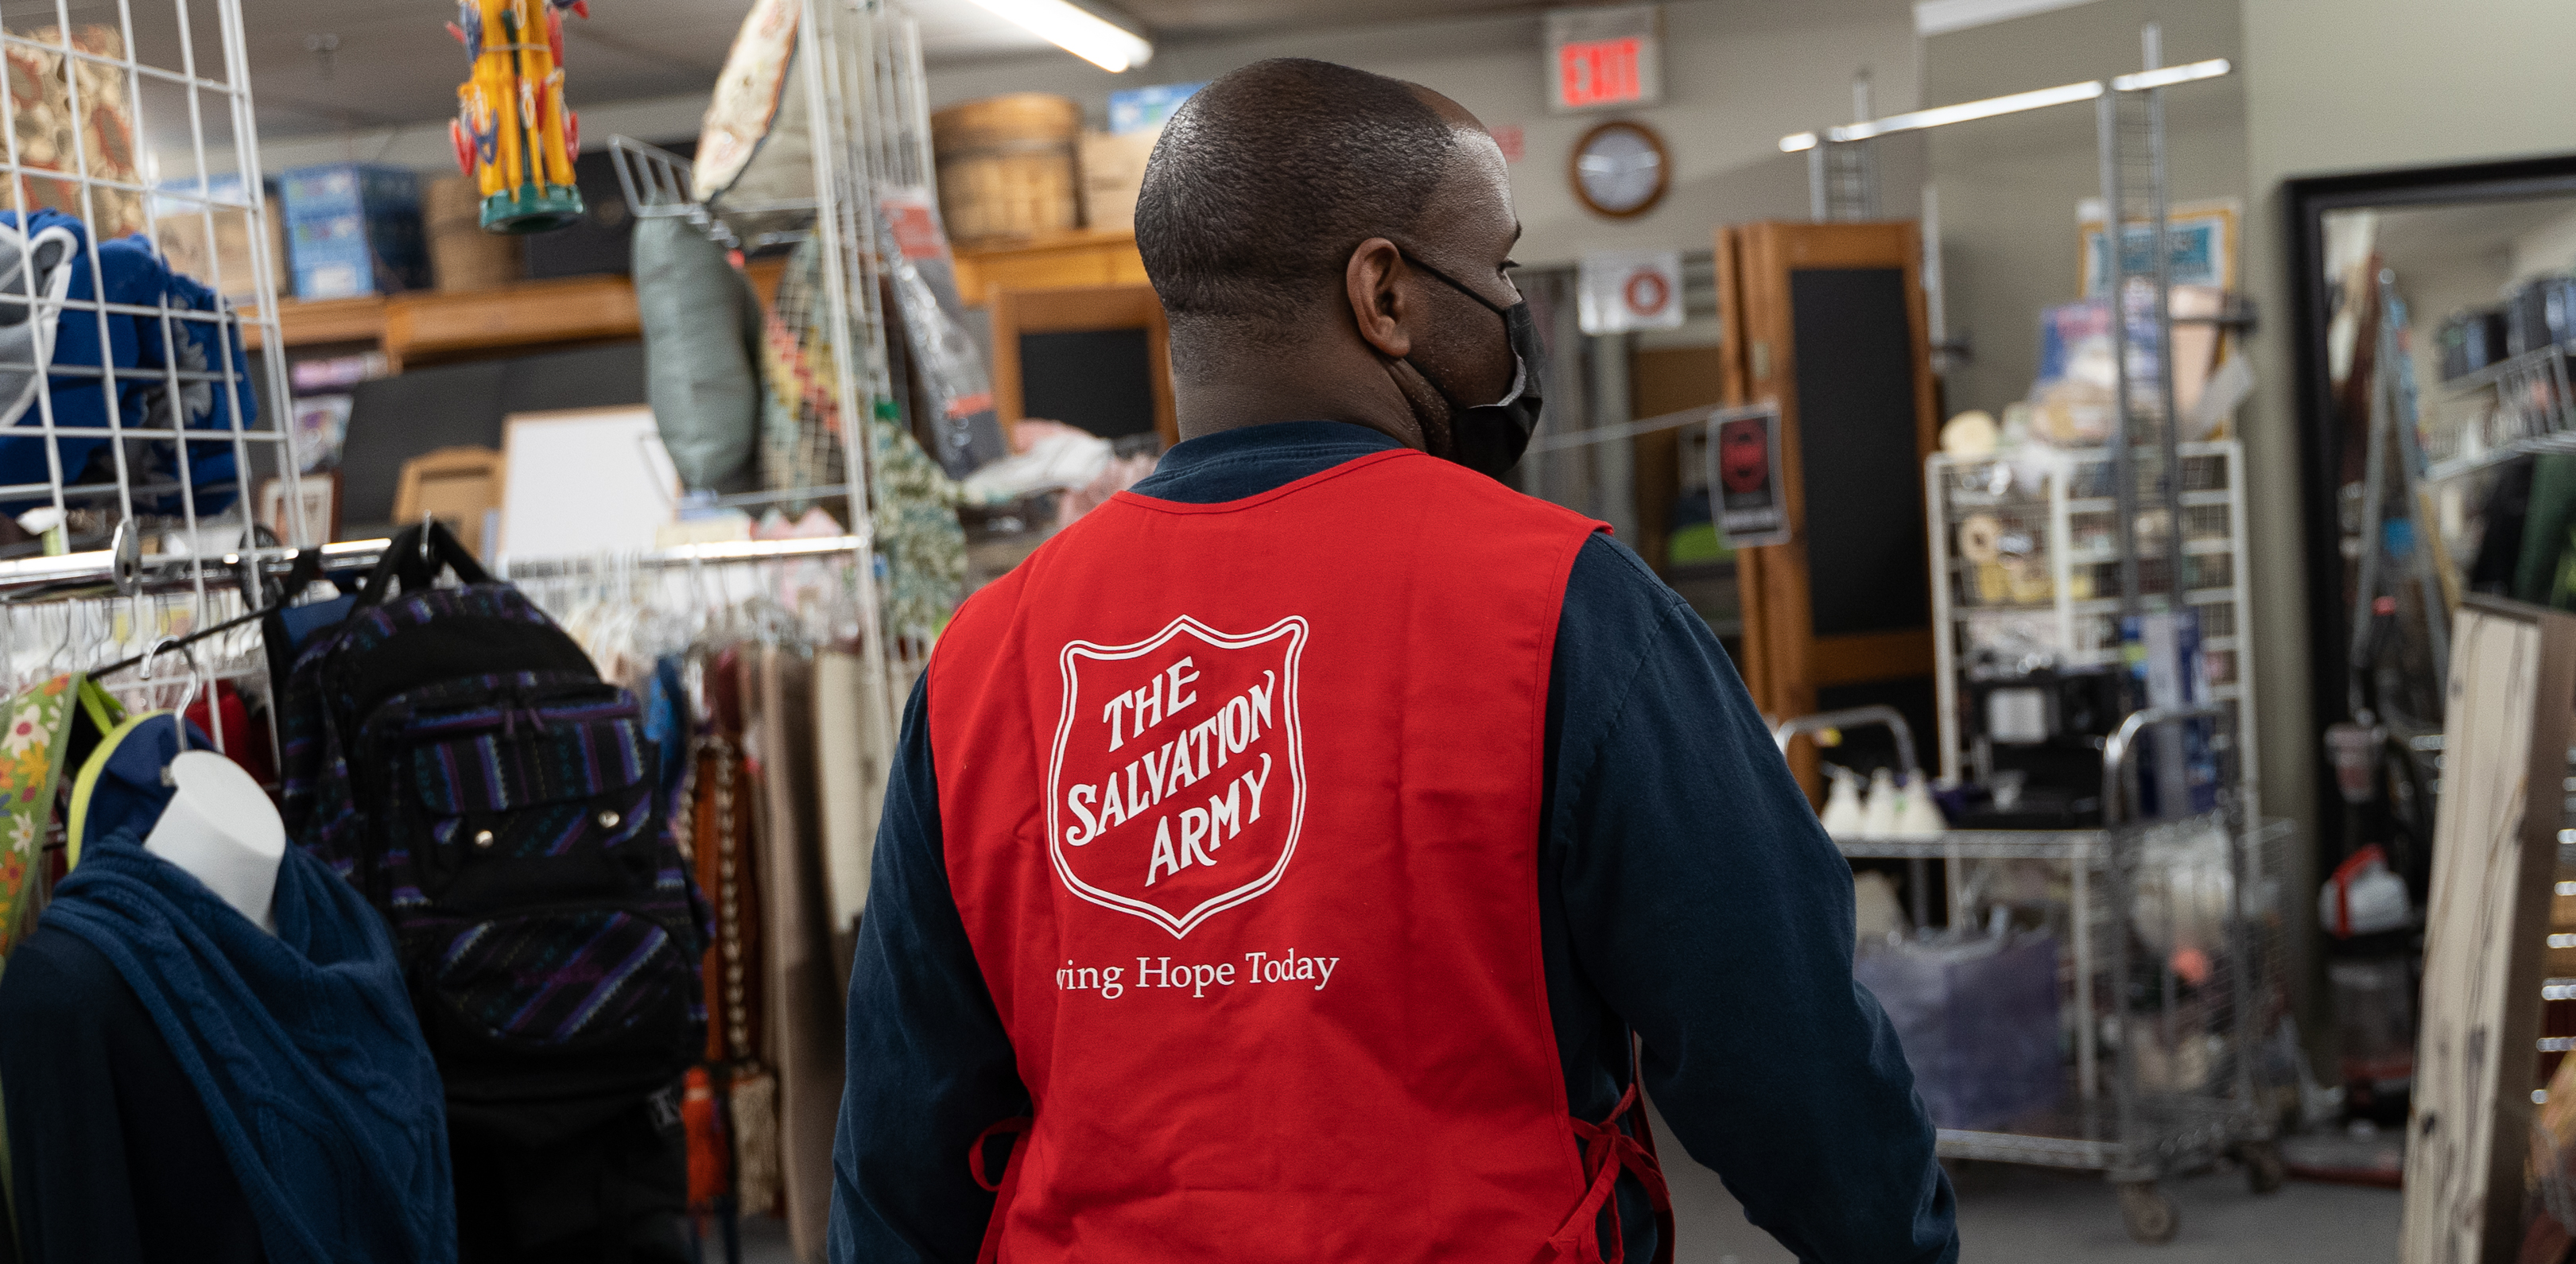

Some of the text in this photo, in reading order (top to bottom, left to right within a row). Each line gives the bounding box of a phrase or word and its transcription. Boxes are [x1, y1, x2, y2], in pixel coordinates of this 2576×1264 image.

[1560, 37, 1640, 107] EXIT
[1103, 656, 1201, 753] THE
[1065, 669, 1275, 847] SALVATION
[1145, 752, 1272, 888] ARMY
[1135, 956, 1236, 999] Hope
[1245, 947, 1340, 991] Today
